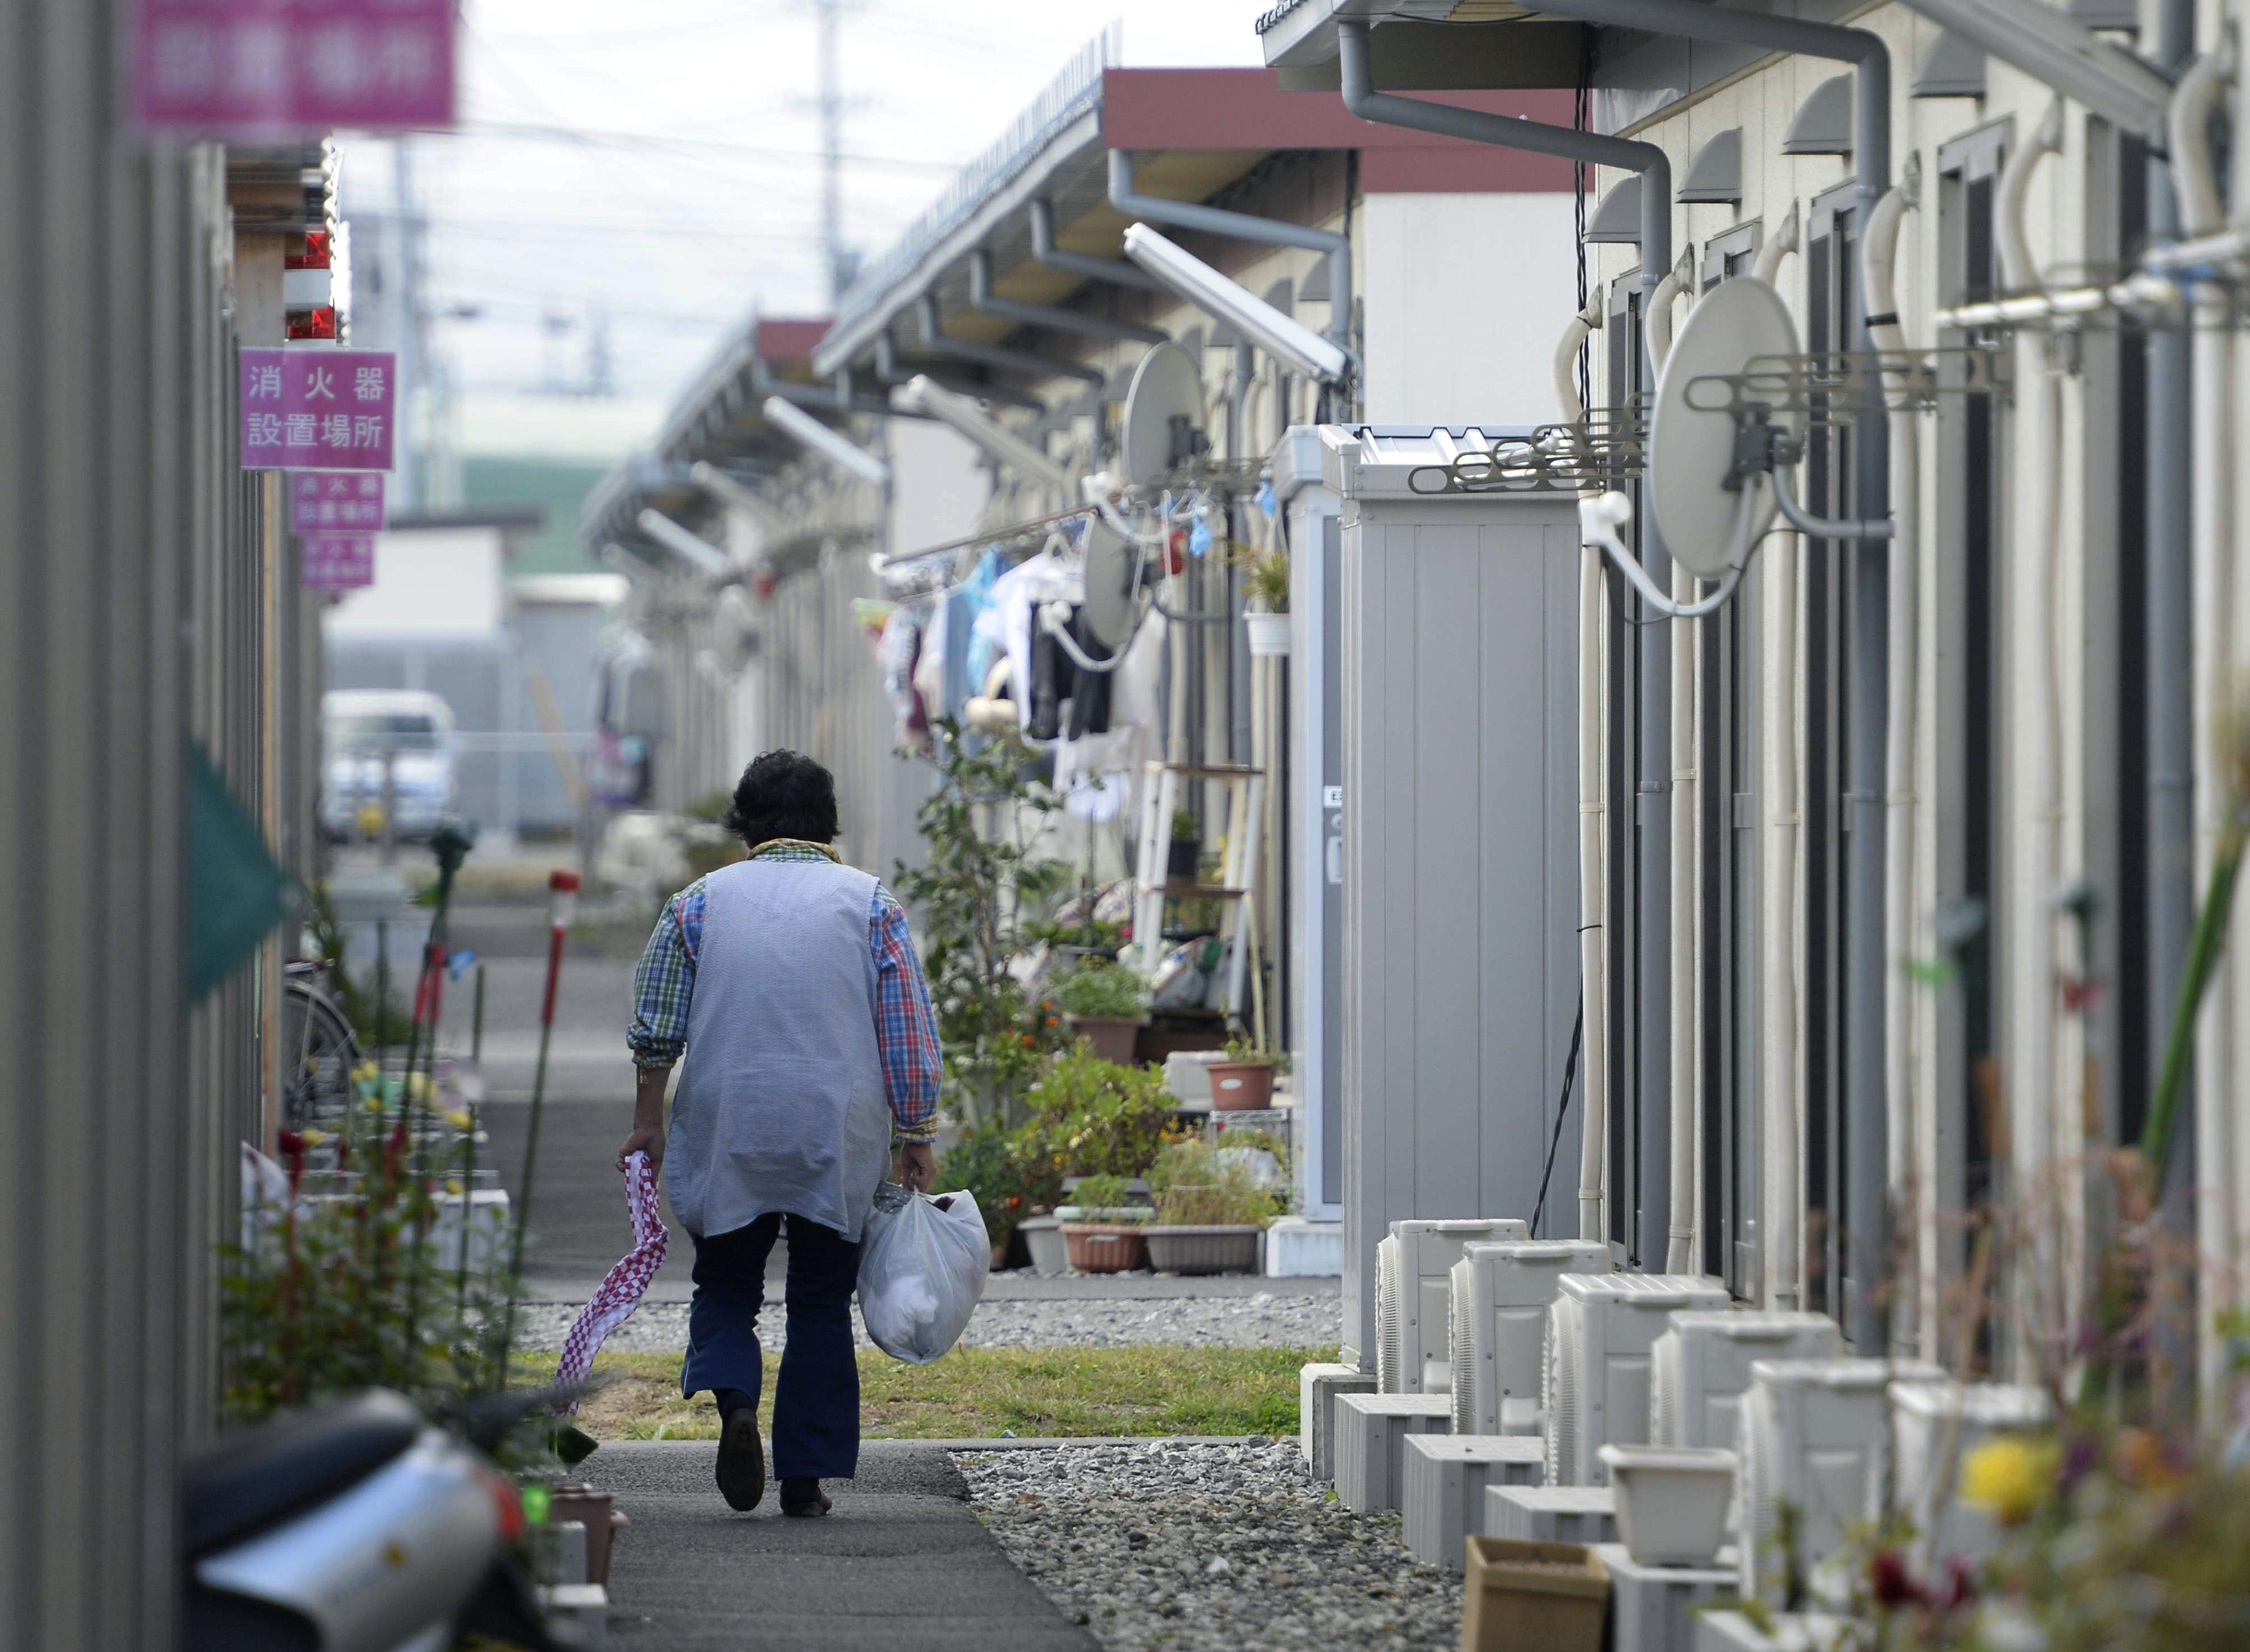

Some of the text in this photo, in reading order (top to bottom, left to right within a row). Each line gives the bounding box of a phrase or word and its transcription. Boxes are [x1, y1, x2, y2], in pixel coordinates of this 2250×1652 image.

[248, 365, 385, 400] 消火器
[247, 413, 383, 448] 設置場所
